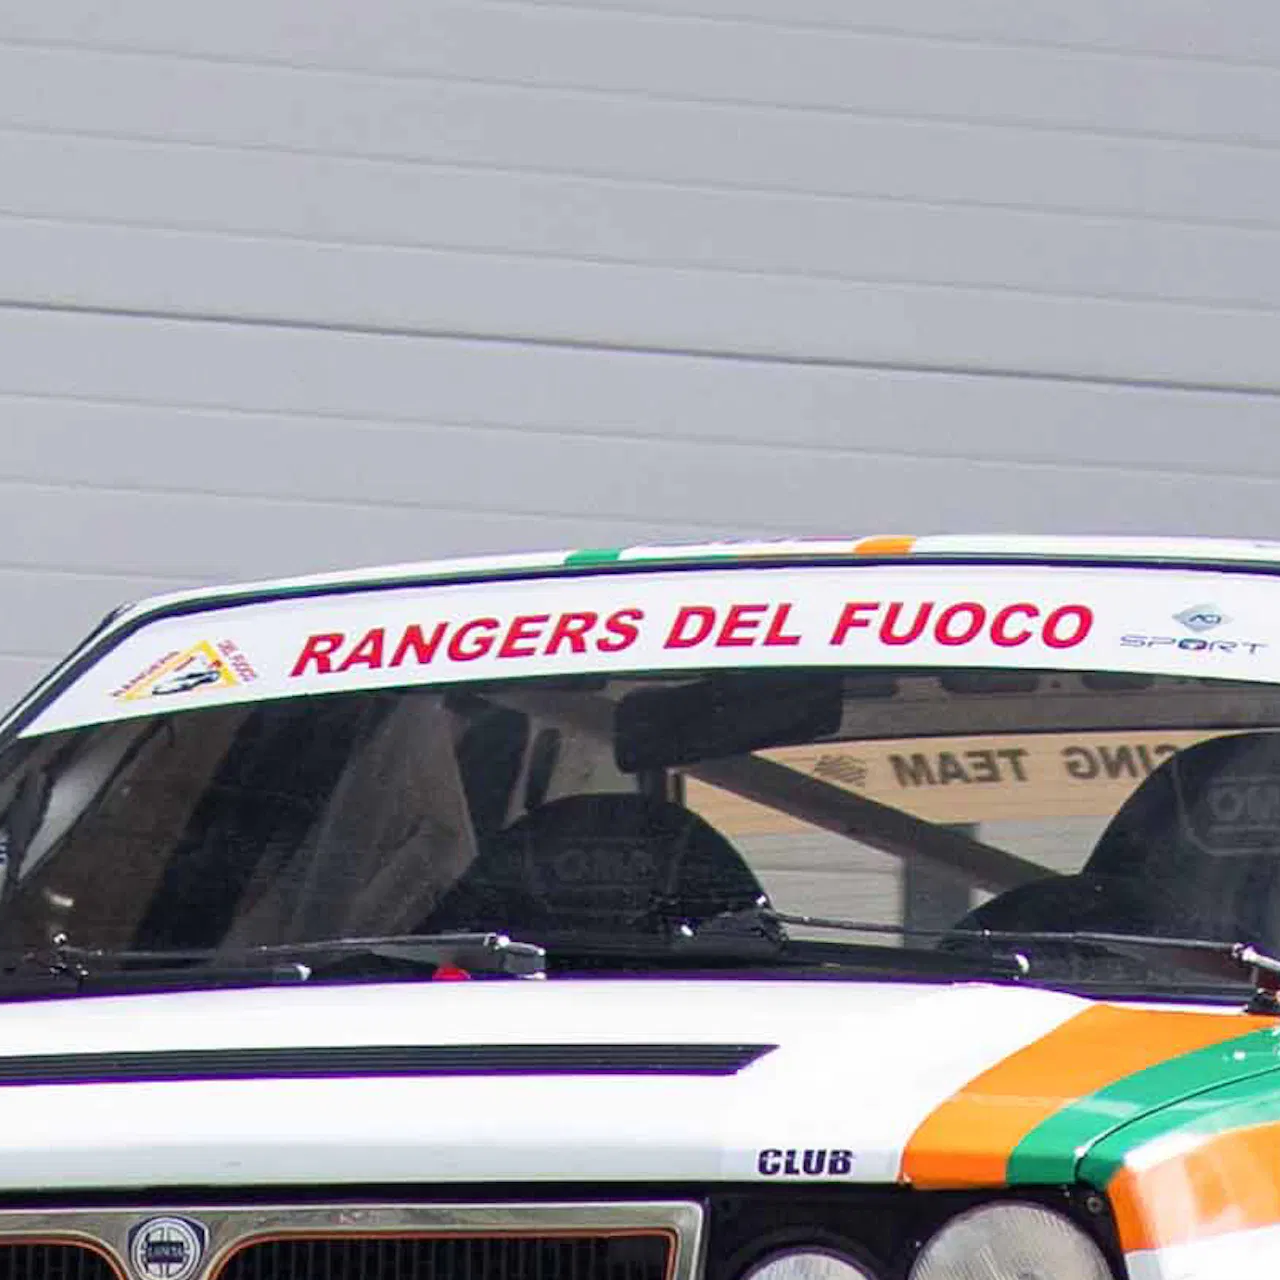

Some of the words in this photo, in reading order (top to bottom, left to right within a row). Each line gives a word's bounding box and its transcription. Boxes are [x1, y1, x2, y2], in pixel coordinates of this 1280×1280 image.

[288, 607, 645, 678] RANGERS
[662, 602, 803, 651] DEL
[828, 600, 1095, 649] FUOCO
[1119, 633, 1270, 655] SPORT
[757, 1148, 854, 1176] CLUB
